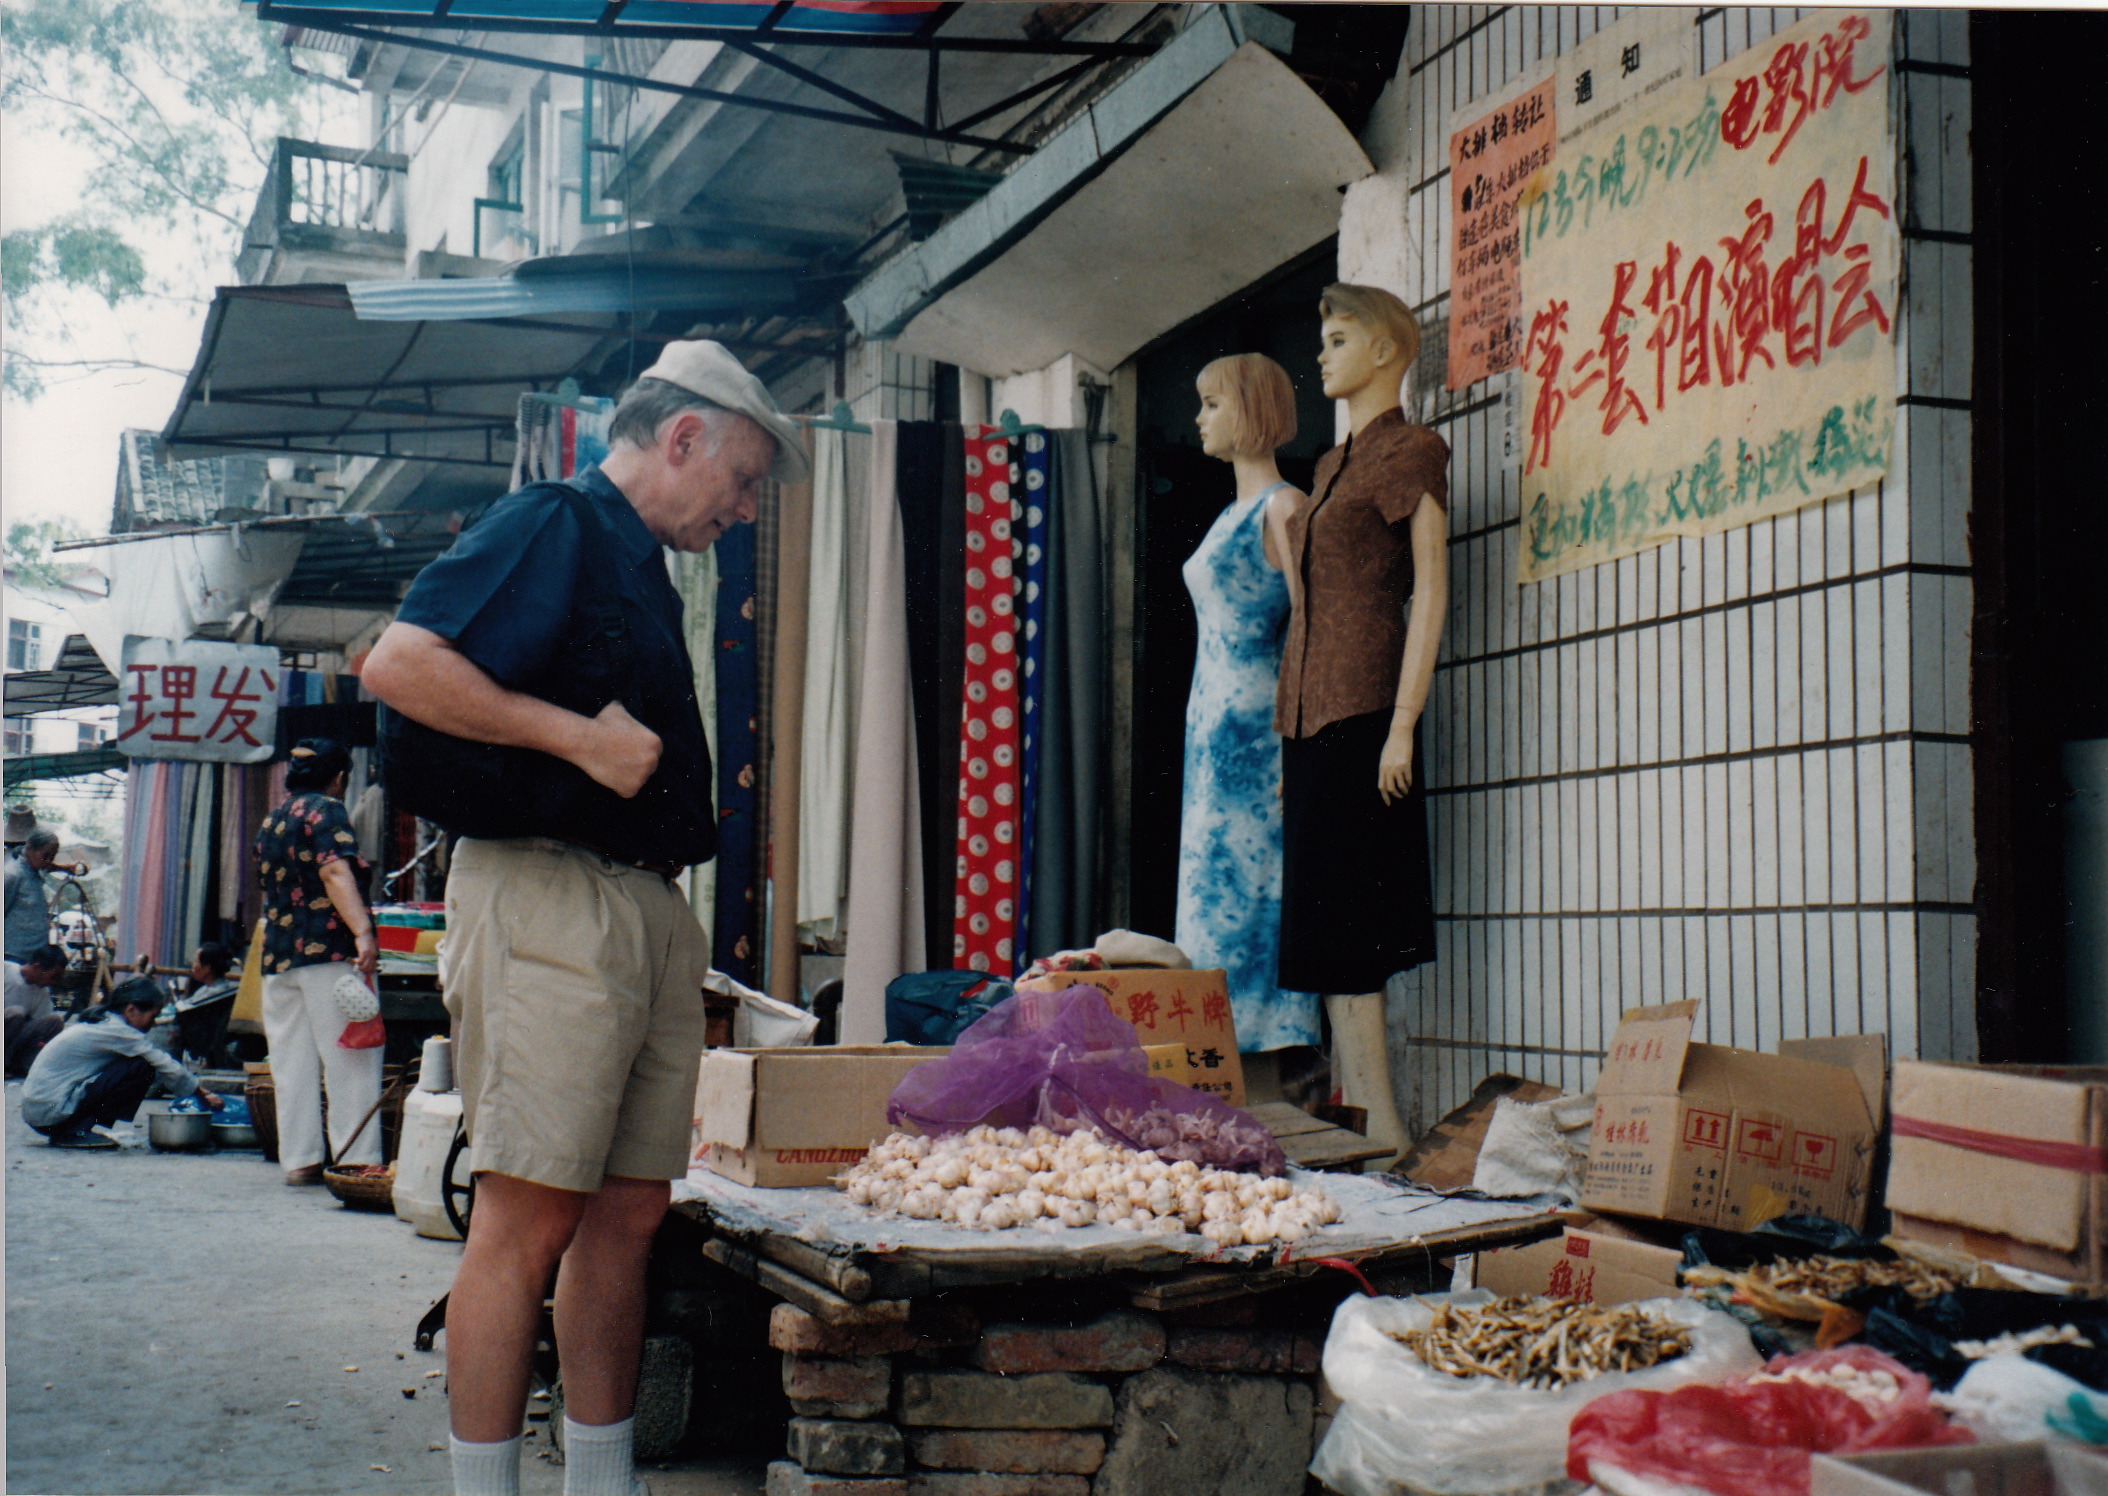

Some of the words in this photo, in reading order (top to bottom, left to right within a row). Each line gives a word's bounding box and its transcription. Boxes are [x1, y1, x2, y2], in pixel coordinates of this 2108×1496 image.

[1575, 42, 1641, 106] 通知
[119, 664, 276, 747] 理发
[1127, 988, 1230, 1034] 野牛牌
